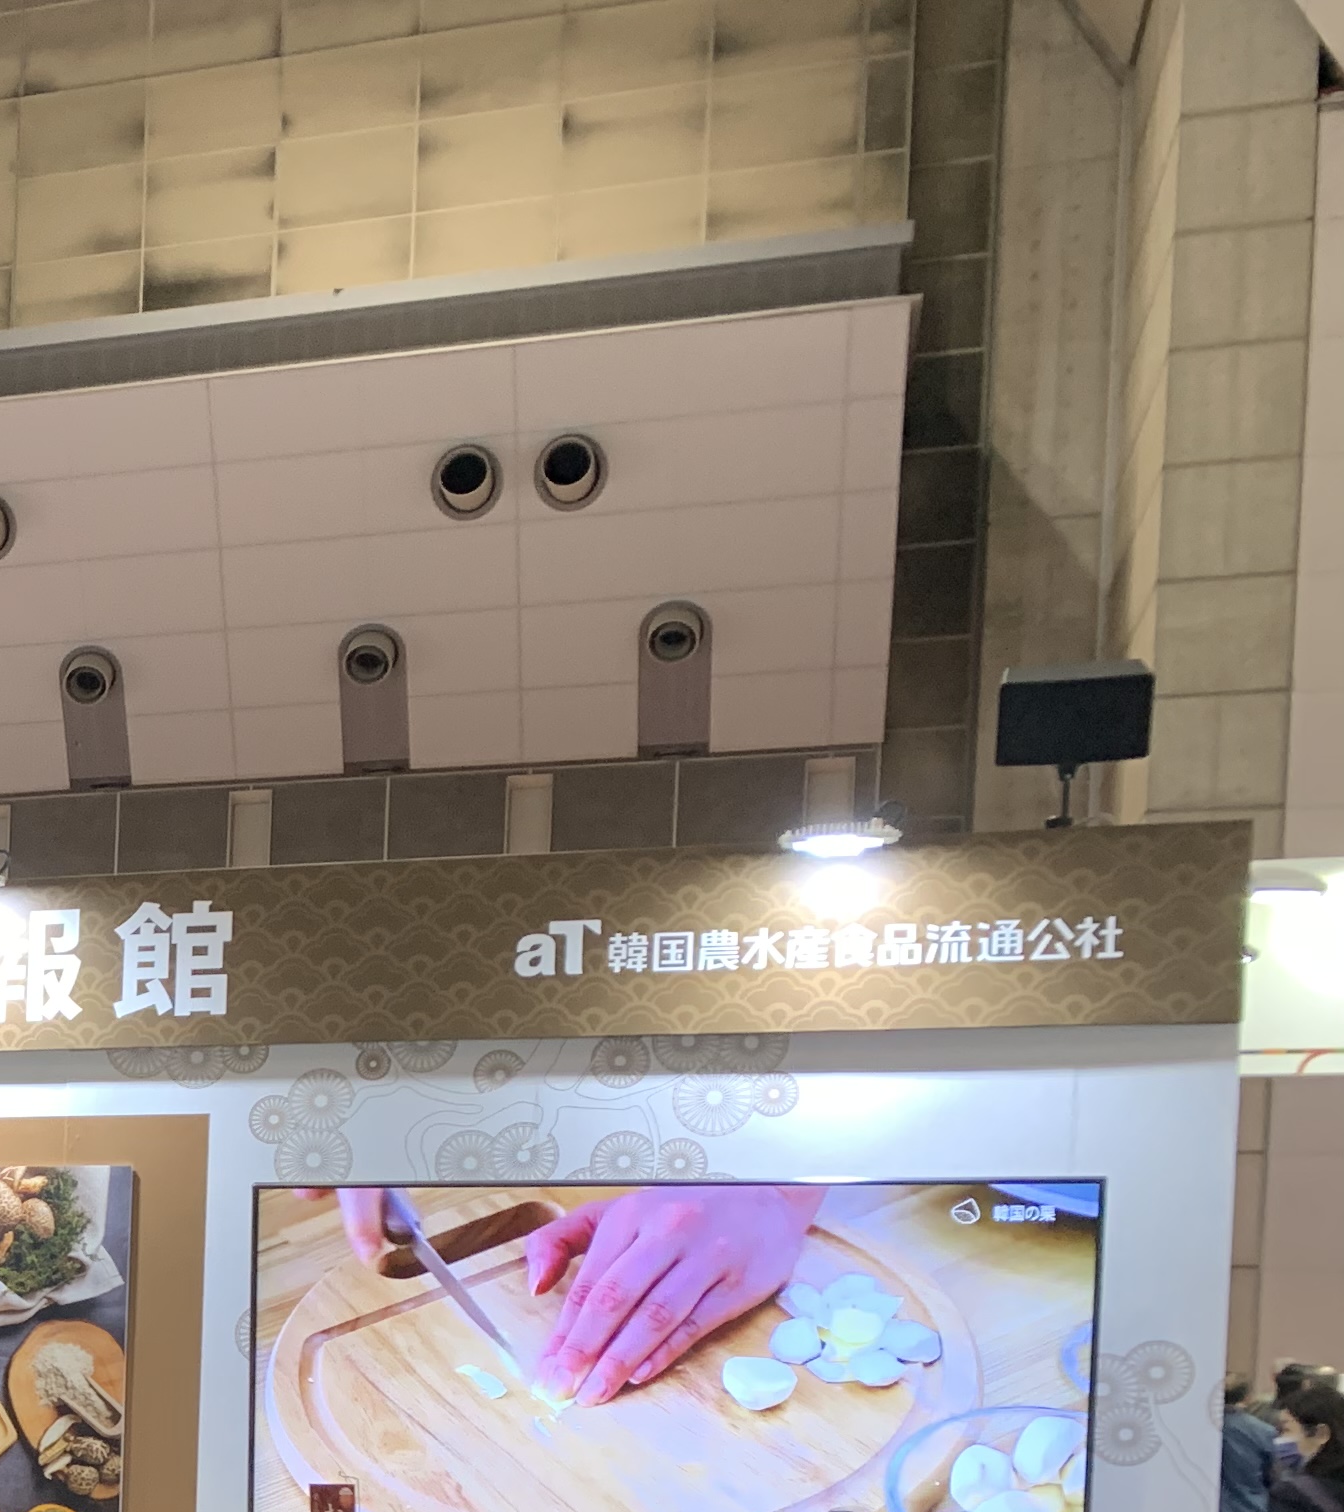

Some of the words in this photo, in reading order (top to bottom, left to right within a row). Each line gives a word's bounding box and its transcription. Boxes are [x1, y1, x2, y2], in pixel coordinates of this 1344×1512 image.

[514, 919, 602, 978] aT
[609, 916, 1124, 973] 韓国農水産食品流通公社
